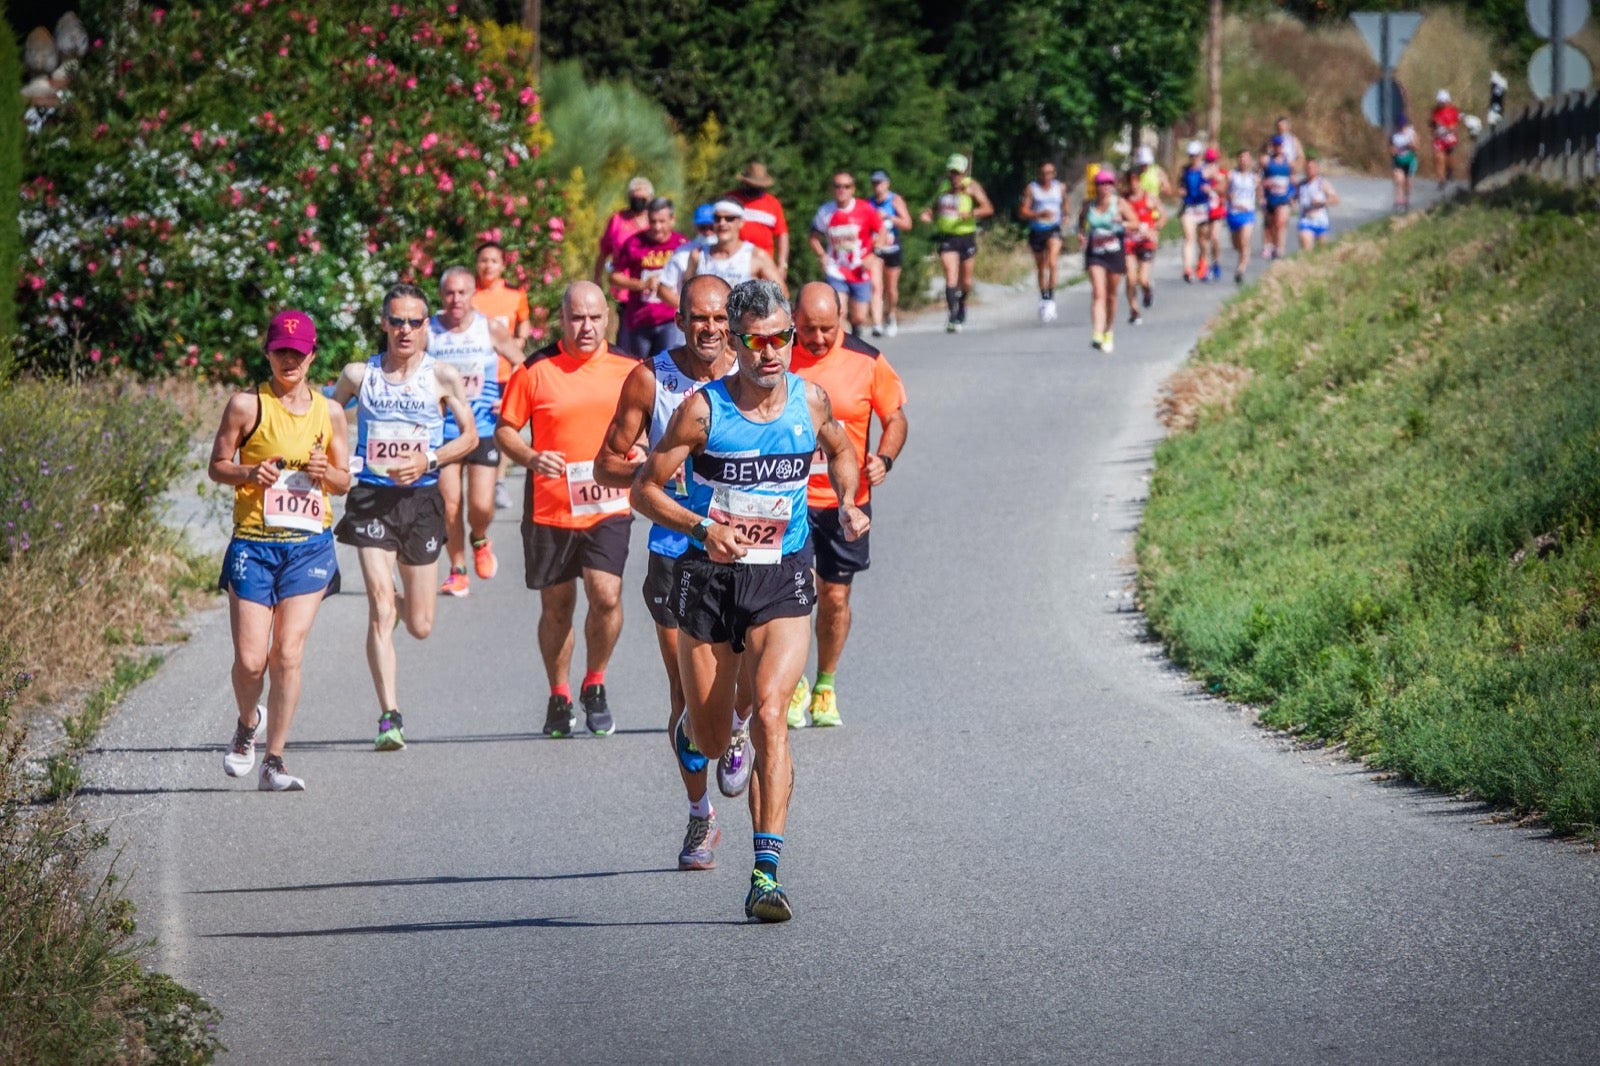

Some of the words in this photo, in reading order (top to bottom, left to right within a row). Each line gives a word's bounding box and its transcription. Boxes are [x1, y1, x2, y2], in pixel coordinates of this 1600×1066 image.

[462, 375, 479, 388] 71
[274, 495, 320, 517] 1076
[723, 520, 778, 546] 062
